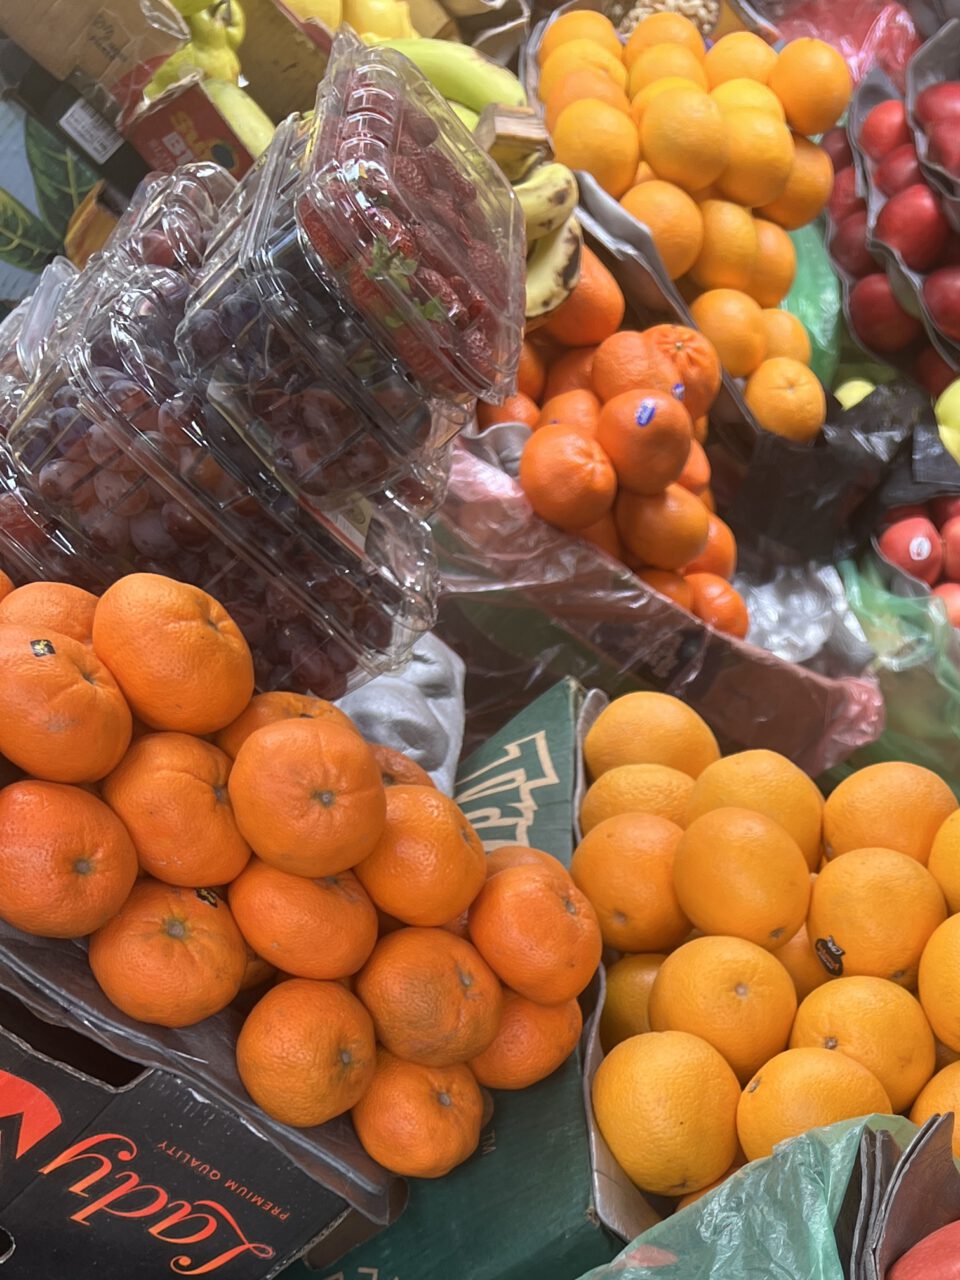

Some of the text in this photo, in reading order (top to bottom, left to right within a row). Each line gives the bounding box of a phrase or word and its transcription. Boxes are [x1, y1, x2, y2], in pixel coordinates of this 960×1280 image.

[38, 1133, 275, 1276] Lady
[157, 1140, 291, 1222] PREMIUM QUALITY
